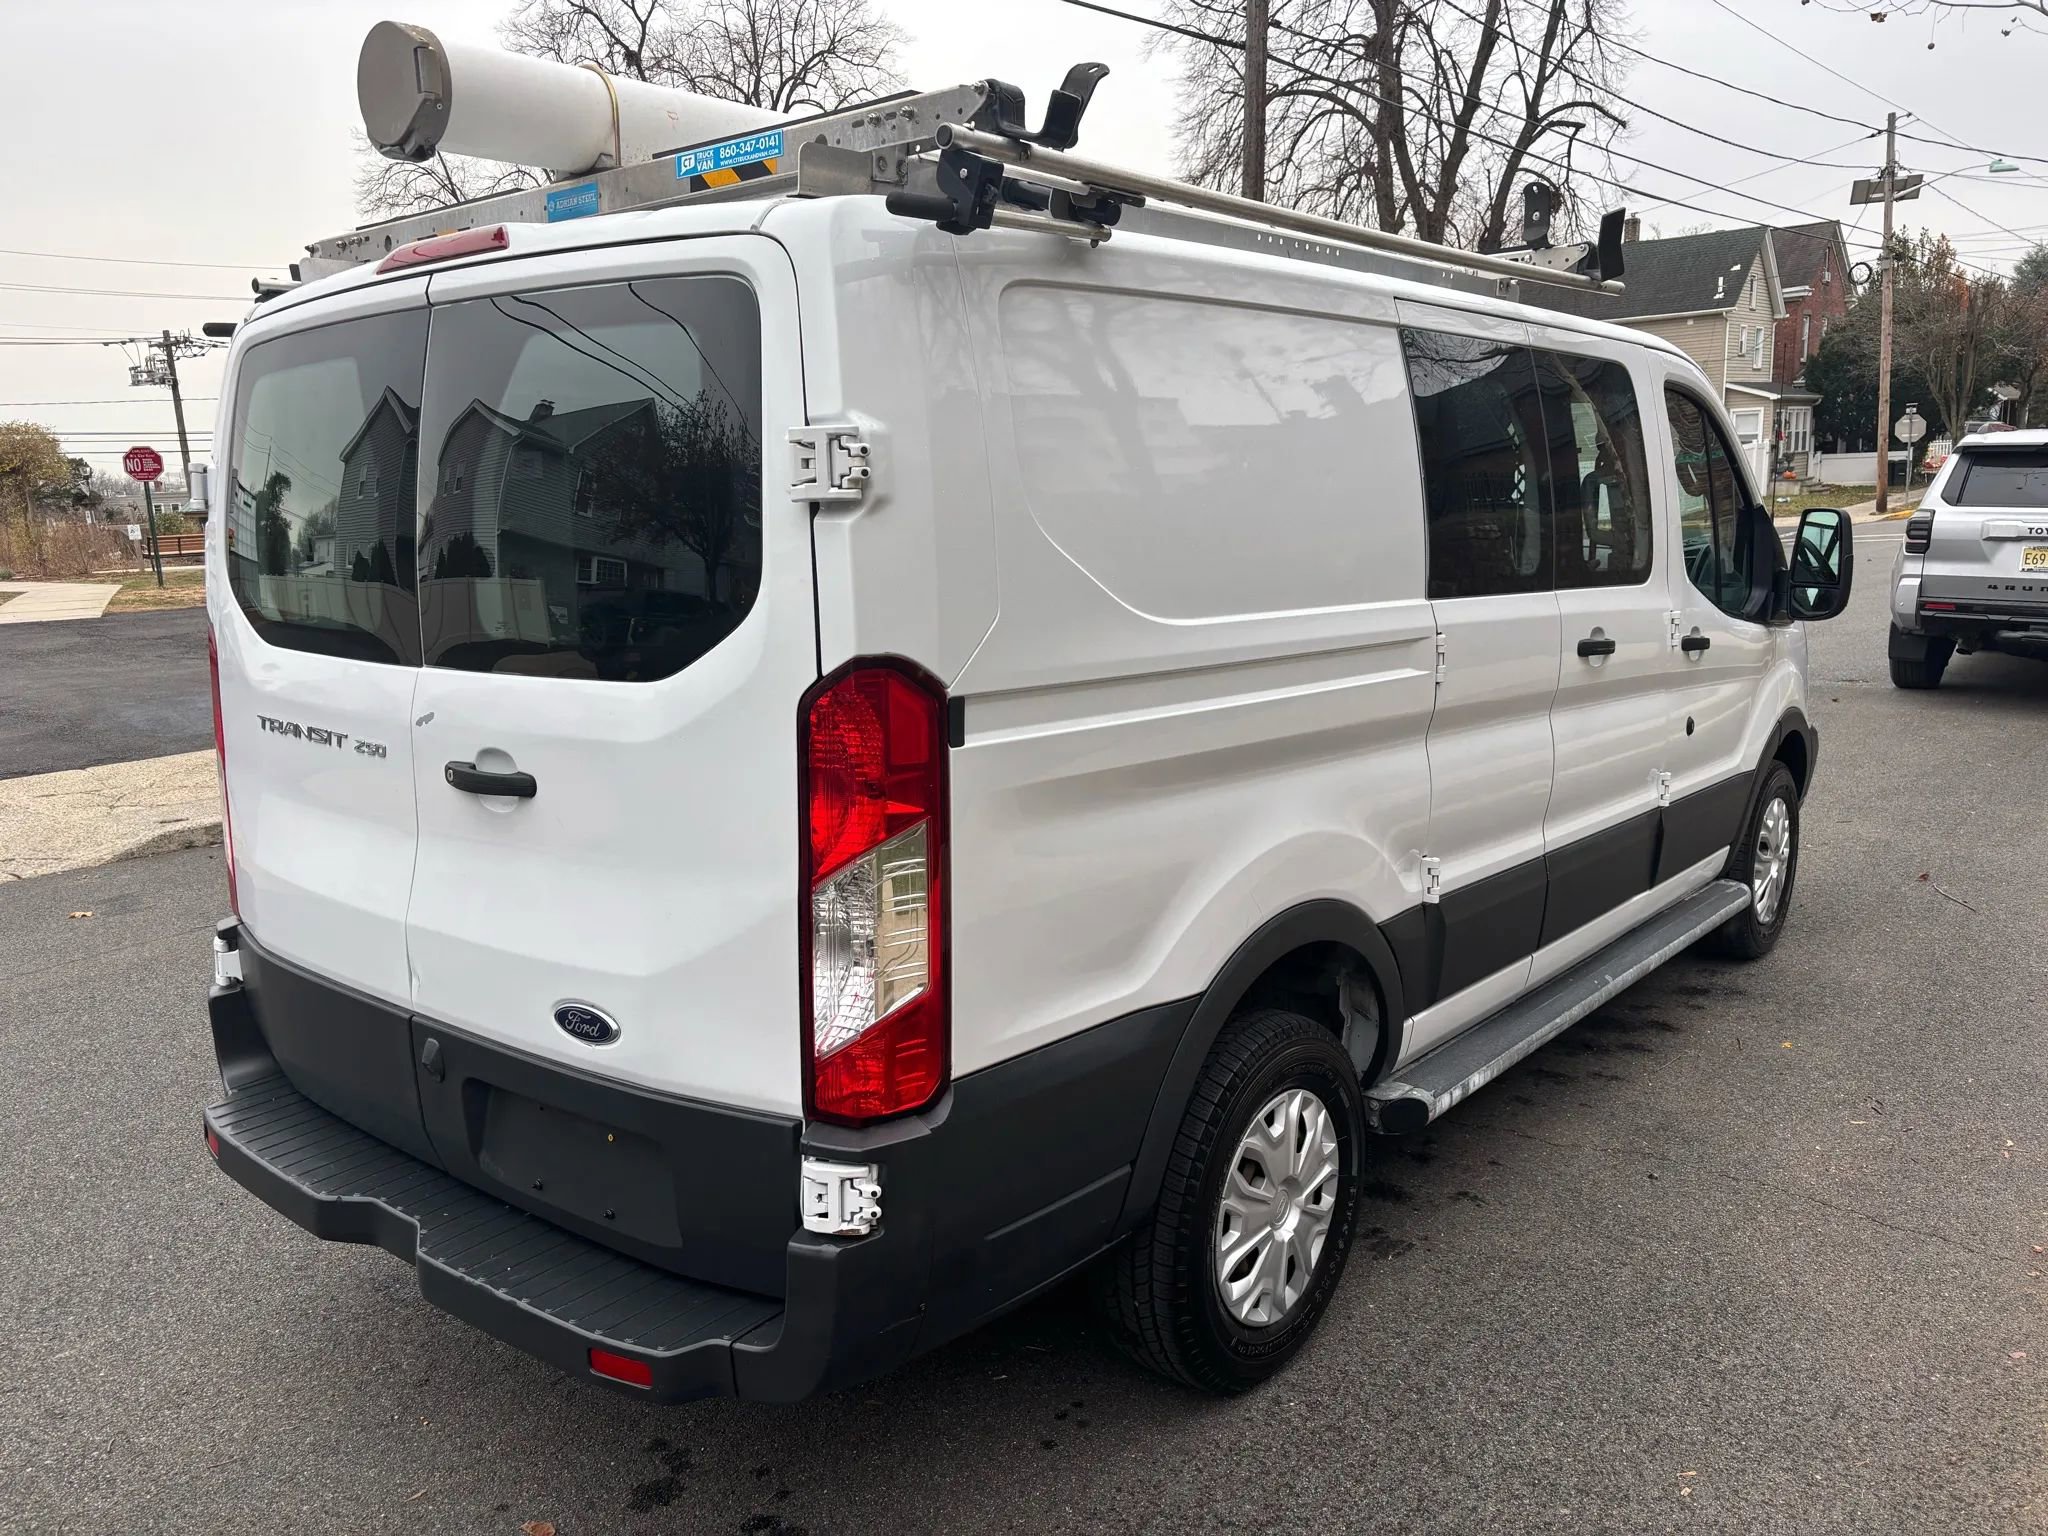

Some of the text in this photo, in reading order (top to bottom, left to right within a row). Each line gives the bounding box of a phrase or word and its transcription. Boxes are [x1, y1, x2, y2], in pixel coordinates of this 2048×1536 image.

[719, 134, 779, 159] 860-347-0141
[697, 149, 714, 161] TRUCK
[683, 157, 694, 169] CT
[696, 160, 714, 172] VAN
[578, 192, 596, 204] STEEL
[126, 458, 142, 472] NO
[2024, 552, 2047, 565] E69
[256, 714, 387, 758] TRANSIT 250
[564, 1010, 601, 1037] Ford
